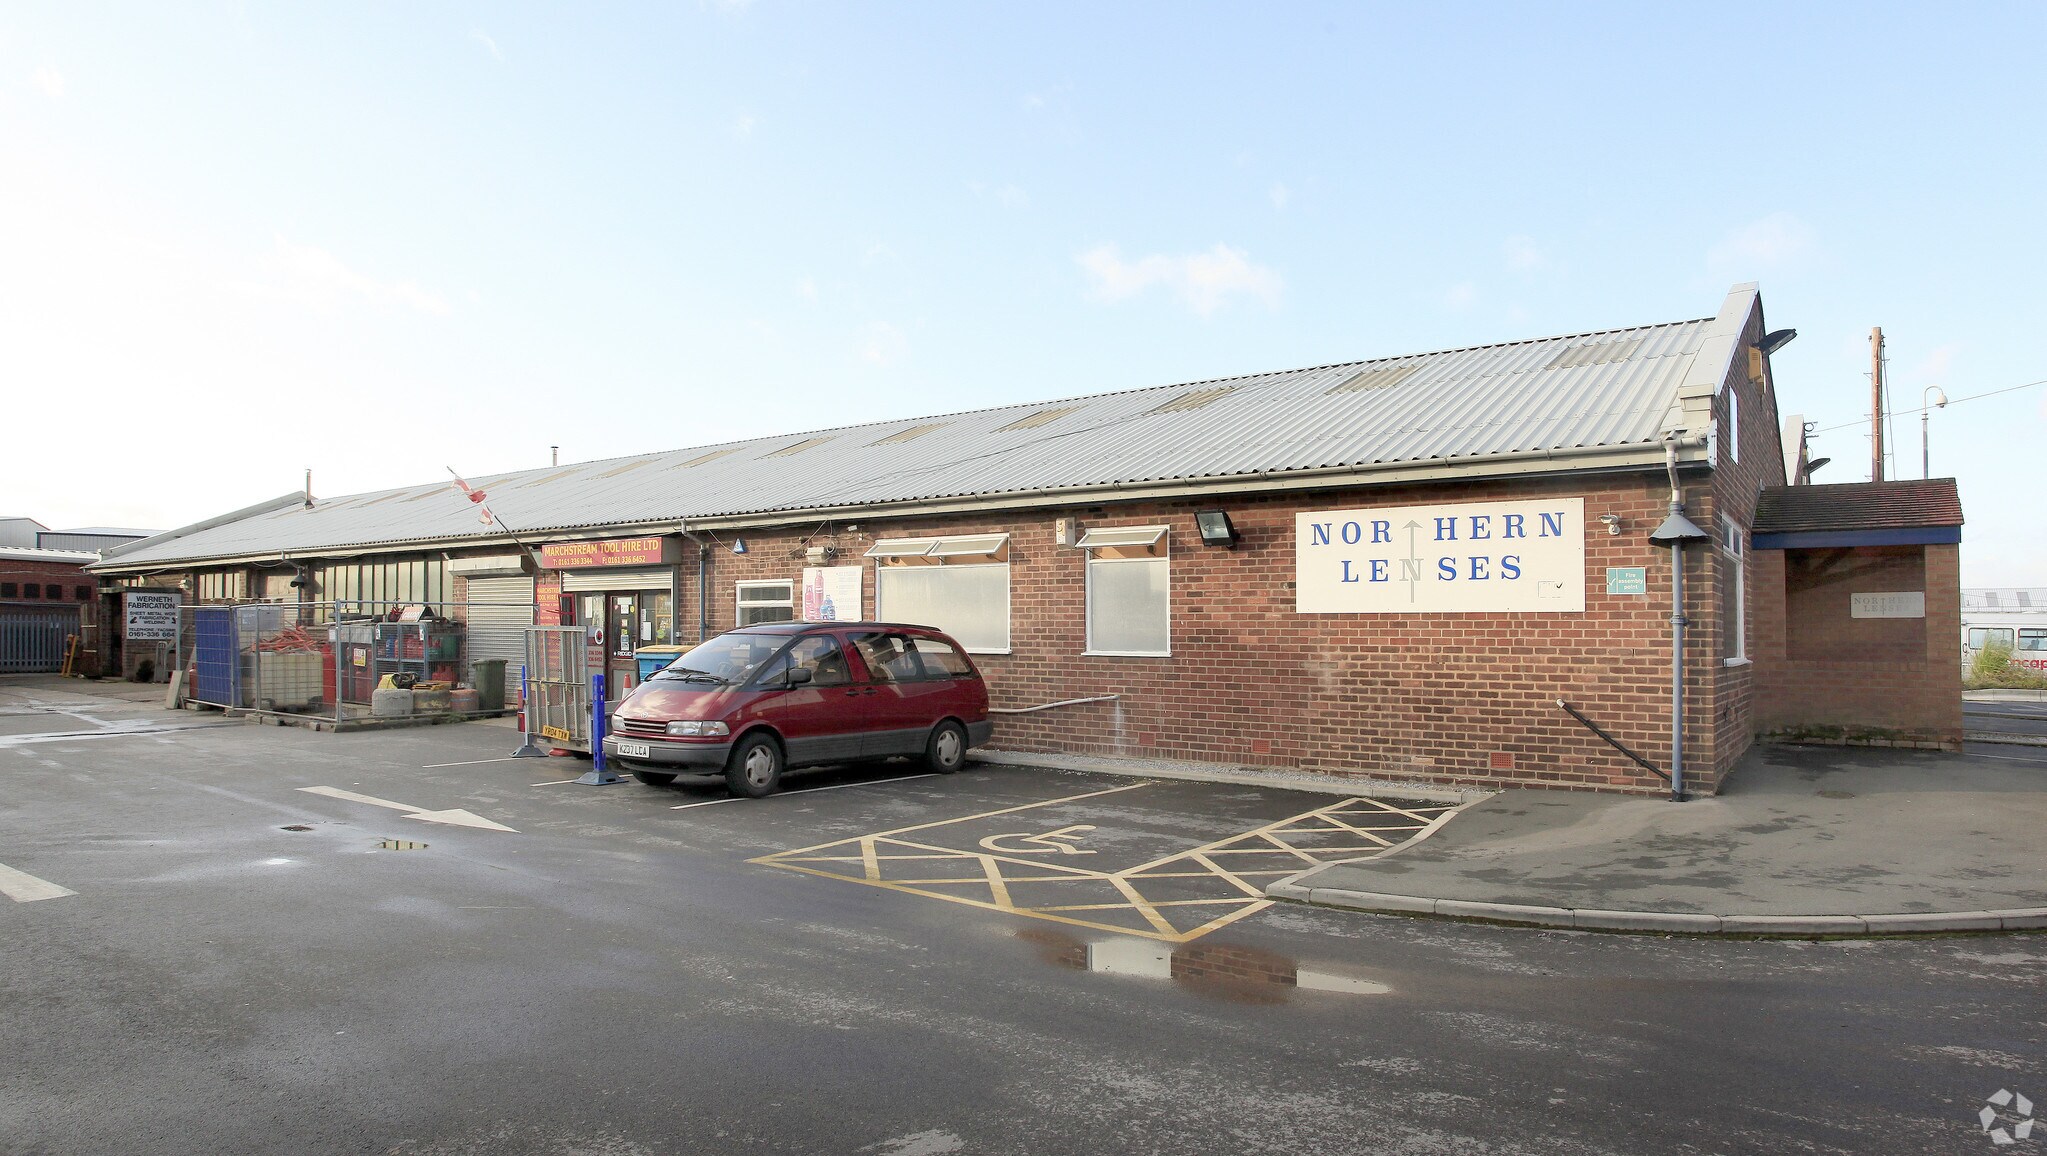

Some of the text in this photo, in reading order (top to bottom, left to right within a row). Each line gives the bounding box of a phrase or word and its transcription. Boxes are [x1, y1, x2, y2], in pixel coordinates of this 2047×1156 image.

[544, 540, 659, 557] MARCHSTREAM TOOL HIRE LTD
[558, 558, 570, 566] 0161
[570, 557, 580, 565] 336
[607, 555, 621, 564] 0161
[1341, 555, 1521, 583] LENSES
